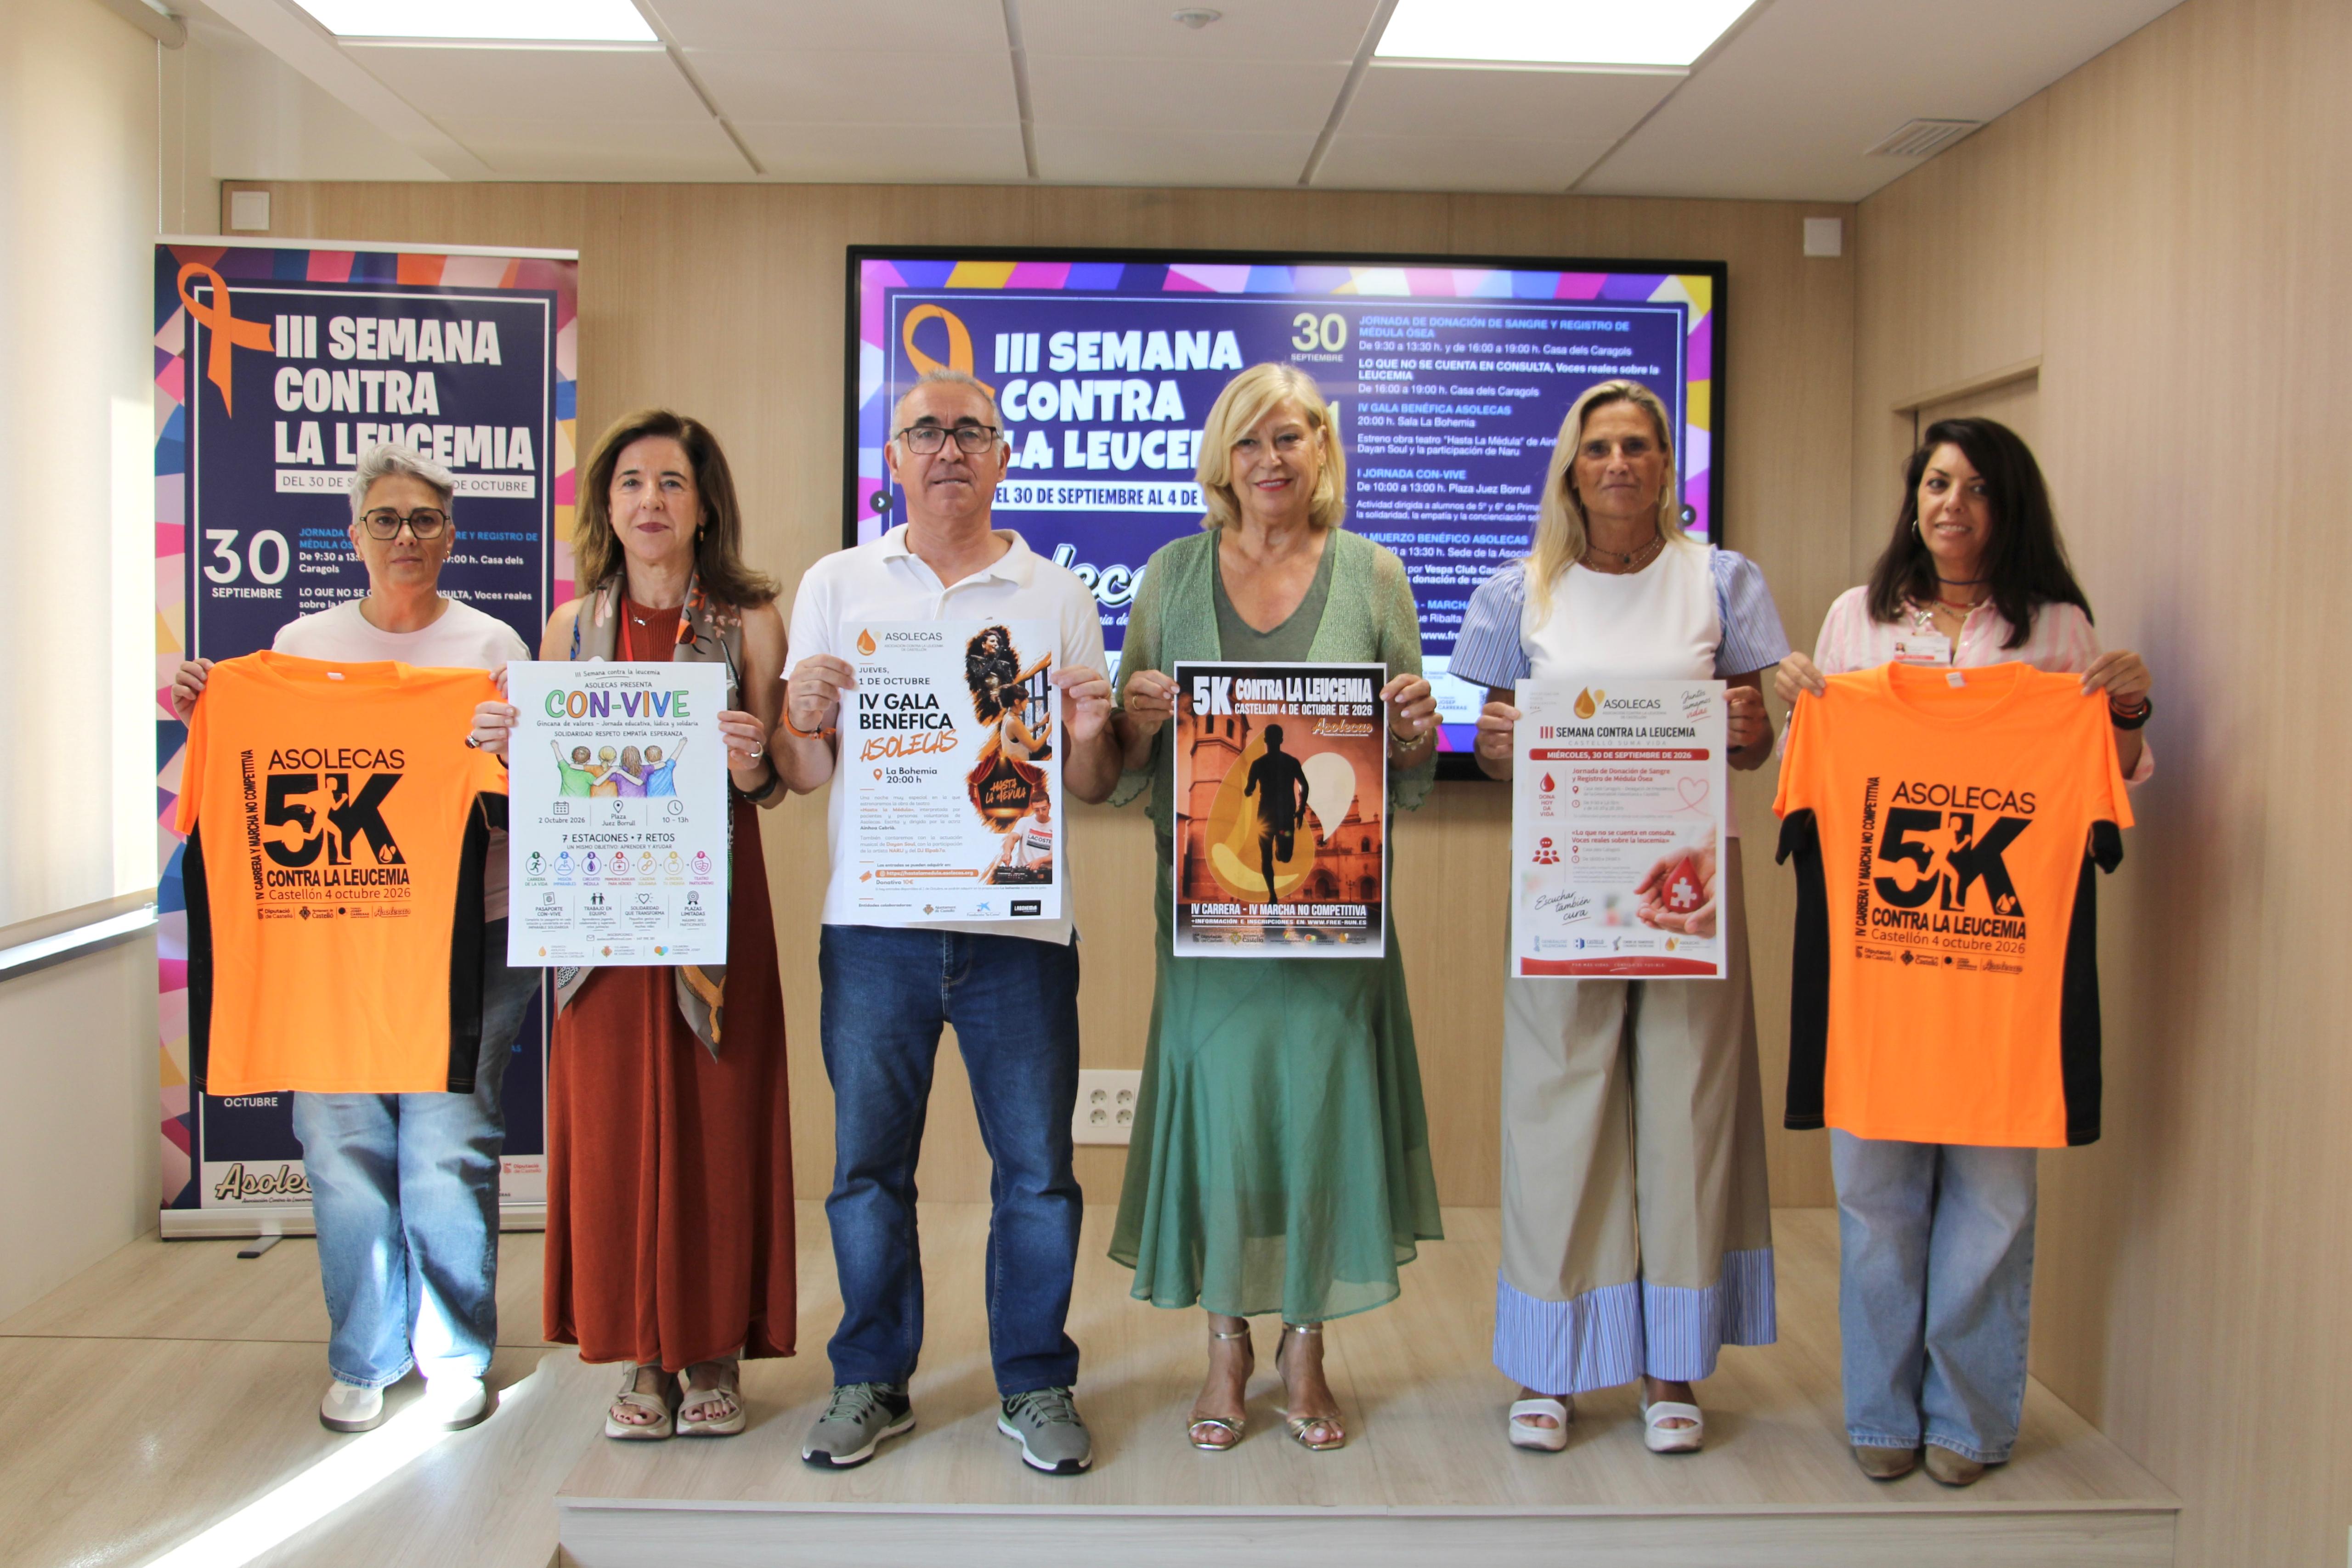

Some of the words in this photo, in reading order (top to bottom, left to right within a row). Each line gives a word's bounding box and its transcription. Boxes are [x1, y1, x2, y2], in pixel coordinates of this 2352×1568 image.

[1359, 316, 1410, 327] JORNADA
[1412, 317, 1426, 327] DE
[1429, 316, 1485, 327] DONACIÓN
[1488, 318, 1502, 328] DE
[1505, 319, 1547, 328] SANGRE
[1550, 320, 1557, 329] Y
[1560, 320, 1611, 330] REGISTRO
[1614, 321, 1629, 331] DE
[276, 315, 317, 358] III
[328, 317, 501, 365] SEMANA
[1291, 313, 1347, 352] 30
[995, 333, 1040, 373] III
[1048, 331, 1243, 372] SEMANA
[1291, 354, 1343, 362] SEPTIEMBRE
[274, 368, 439, 415] CONTRA
[1001, 380, 1185, 422] CONTRA
[1358, 402, 1369, 413] IV
[1370, 402, 1399, 413] GALA
[1401, 403, 1453, 413] BENÉFICA
[1455, 405, 1511, 415] ASOLECAS
[1357, 416, 1385, 426] 20:00
[1386, 417, 1395, 425] h.
[1397, 417, 1419, 426] Sala
[1420, 417, 1432, 427] La
[1434, 417, 1475, 427] Bohemia
[276, 421, 324, 465] LA
[1005, 430, 1054, 470] LA
[1063, 430, 1204, 471] LEUCE
[283, 476, 304, 487] DEL
[309, 476, 323, 487] 30
[328, 477, 342, 487] DE
[471, 481, 527, 491] OCTUBRE
[1014, 487, 1032, 503] 30
[1037, 488, 1053, 504] DE
[1058, 488, 1143, 504] SEPTIEMBRE
[1148, 490, 1163, 505] AL
[1168, 490, 1176, 505] 4
[1181, 490, 1197, 505] DE
[300, 539, 338, 549] MÉDULA
[477, 532, 524, 541] REGISTRO
[526, 532, 537, 542] DE
[204, 528, 289, 584] 30
[469, 555, 478, 564] h.
[481, 555, 503, 564] Casa
[505, 556, 524, 565] dels
[299, 564, 339, 575] Caragols
[212, 588, 282, 598] SEPTIEMBRE
[474, 591, 502, 600] Voces
[504, 592, 532, 600] reales
[860, 694, 879, 709] IV
[884, 694, 939, 709] GALA
[1193, 676, 1232, 715] 5K
[1235, 679, 1283, 701] CONTRA
[1286, 678, 1303, 702] LA
[1305, 678, 1372, 702] LEUCEMIA
[1602, 699, 1660, 708] ASOLECAS
[545, 690, 690, 718] CON-VIVE
[1234, 703, 1278, 715] CASTELLON
[1281, 704, 1286, 714] 4
[1289, 704, 1299, 715] DE
[1301, 704, 1336, 715] OCTUBRE
[1339, 705, 1349, 715] DE
[1352, 705, 1372, 716] 2026
[860, 710, 953, 729] BENÉFICA
[1312, 718, 1372, 734] Asolecas
[1540, 726, 1553, 739] III
[1556, 727, 1594, 737] SEMANA
[1597, 727, 1633, 737] CONTRA
[1636, 728, 1646, 737] LA
[1650, 727, 1695, 737] LEUCEMIA
[860, 729, 958, 762] ASOLECAS
[268, 748, 405, 770] ASOLECAS
[1547, 751, 1590, 759] MIÉRCOLES,
[241, 749, 257, 801] COMPETITIVA
[1892, 781, 2035, 814] ASOLECAS
[245, 802, 257, 813] NO
[263, 773, 406, 868] 5K
[247, 814, 260, 848] MARCHA
[562, 834, 567, 843] 7
[572, 834, 628, 842] ESTACIONES
[637, 833, 641, 842] 7
[646, 833, 674, 842] RETOS
[1028, 834, 1052, 844] LACOSTE
[1873, 807, 2033, 917] 5K
[251, 855, 263, 890] CARRERA
[266, 870, 321, 887] CONTRA
[324, 869, 341, 887] LA
[344, 868, 410, 886] LEUCEMIA
[269, 888, 322, 900] Castellón
[326, 889, 332, 899] 4
[335, 888, 380, 899] octubre
[383, 888, 411, 898] 2026
[1535, 890, 1576, 910] Escuchar
[1191, 903, 1199, 914] IV
[1202, 904, 1240, 915] CARRERA
[1249, 904, 1257, 915] IV
[1260, 904, 1294, 915] MARCHA
[1297, 904, 1309, 915] NO
[1311, 904, 1367, 916] COMPETITIVA
[1556, 898, 1590, 912] también
[1563, 910, 1588, 921] cura
[1872, 908, 1928, 931] CONTRA
[1933, 914, 1950, 933] LA
[1954, 917, 2026, 939] LEUCEMIA
[1871, 928, 1928, 944] Castellón
[1932, 935, 1939, 945] 4
[1943, 936, 1992, 950] octubre
[1996, 940, 2025, 953] 2026
[224, 1097, 277, 1107] OCTUBRE
[215, 1163, 312, 1200] Asolec
